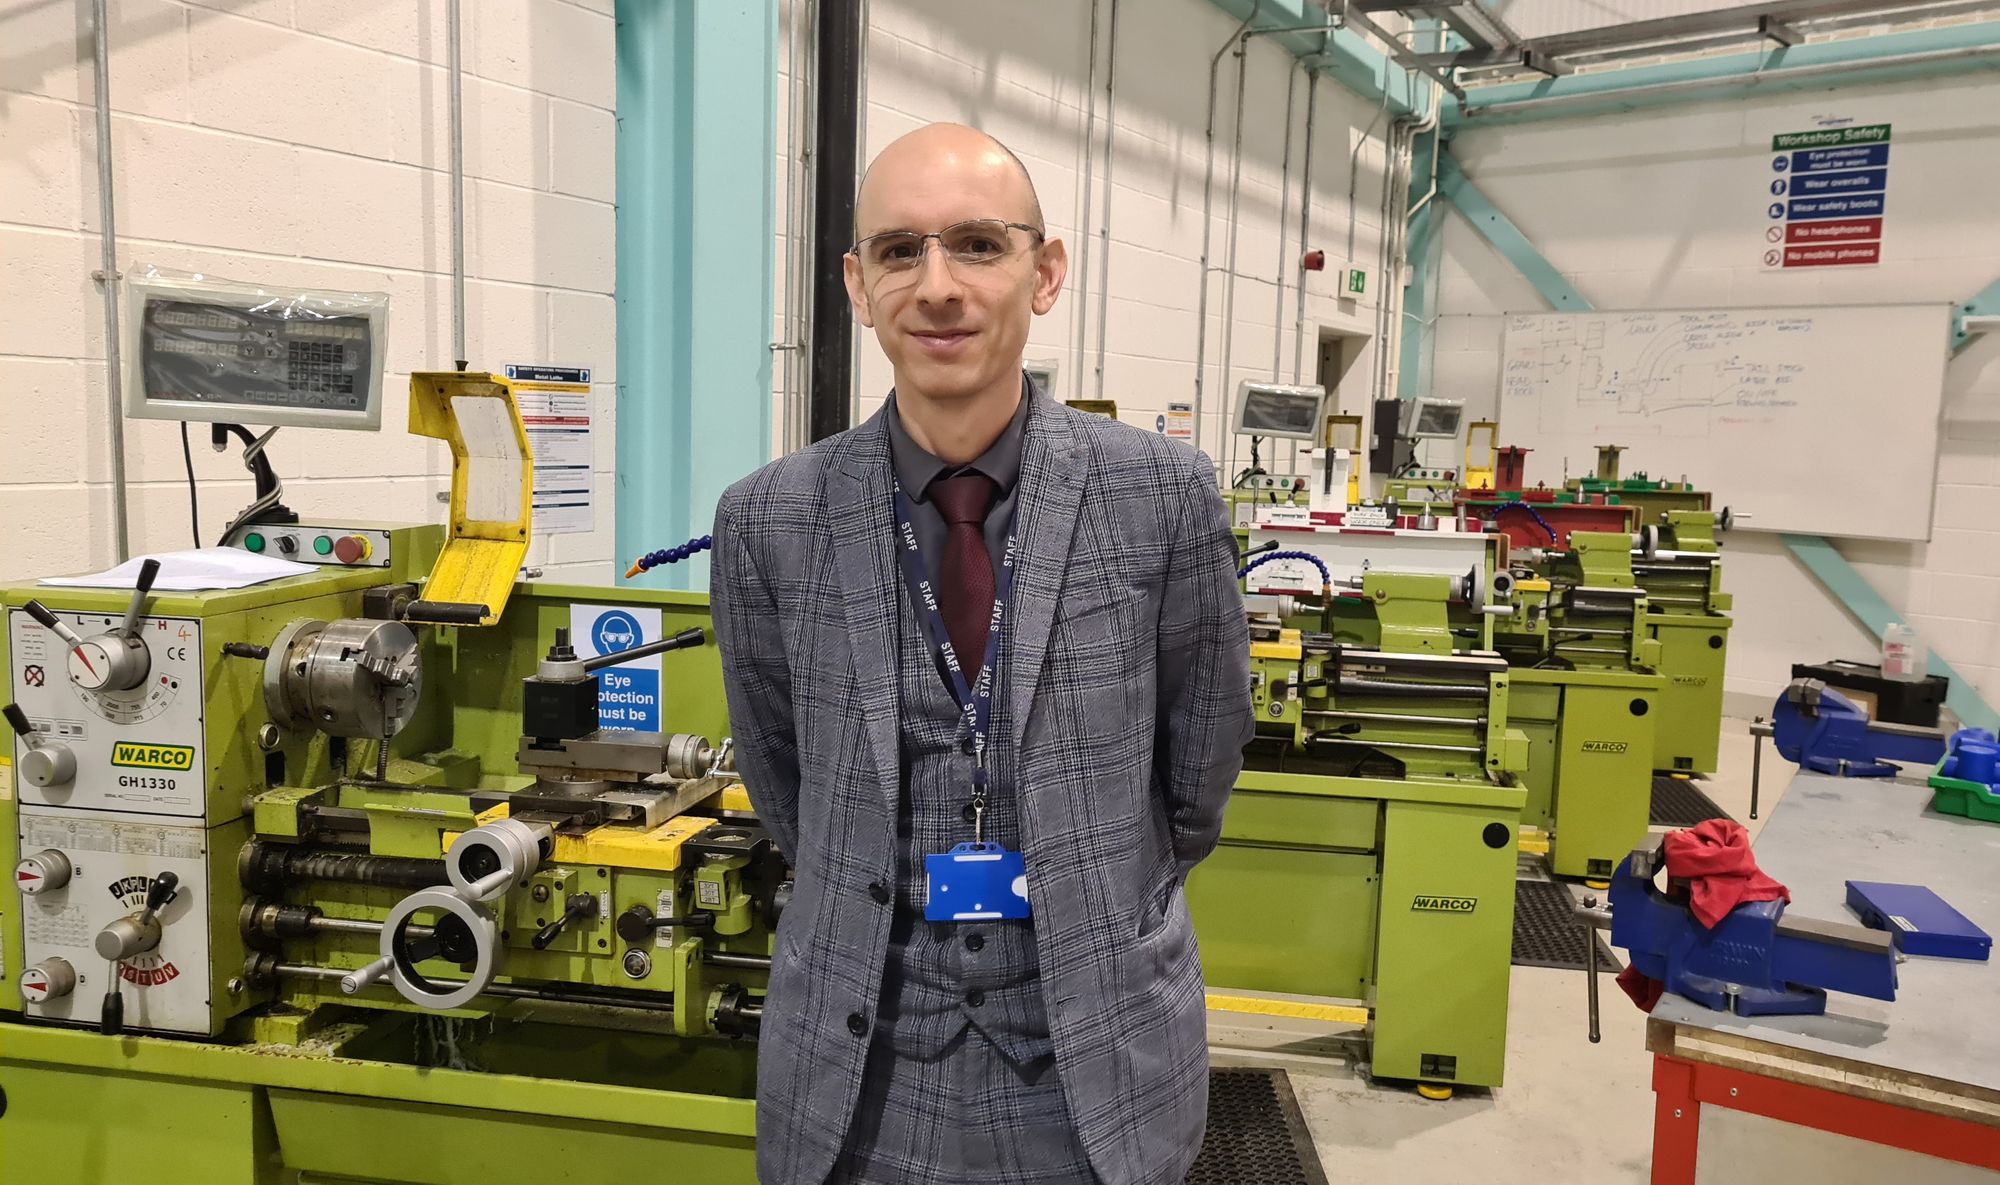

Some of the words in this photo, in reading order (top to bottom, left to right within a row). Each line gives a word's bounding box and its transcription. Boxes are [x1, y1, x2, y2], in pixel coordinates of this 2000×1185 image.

[1778, 132, 1841, 147] Workshop
[1844, 127, 1886, 141] Safety
[1809, 152, 1825, 161] Eye
[1826, 148, 1870, 160] protection
[1833, 160, 1844, 168] be
[1846, 159, 1868, 167] worn
[1805, 180, 1829, 189] Wear
[1830, 177, 1870, 187] overalls
[1793, 203, 1817, 212] Wear
[1818, 201, 1848, 211] safety
[1849, 199, 1878, 209] boots
[1795, 228, 1810, 237] No
[1811, 225, 1871, 237] headphones
[1787, 251, 1802, 260] No
[1803, 250, 1836, 260] mobile
[1837, 249, 1874, 260] phones
[902, 521, 918, 552] STAFF
[1004, 535, 1017, 567] STAFF
[920, 580, 938, 612] STAFF
[990, 599, 1004, 632] STAFF
[77, 616, 85, 626] L
[158, 621, 167, 631] H
[178, 625, 192, 642] 4
[167, 647, 186, 661] CE
[941, 642, 961, 673] STAFF
[605, 673, 631, 689] Eye
[980, 665, 993, 698] STAFF
[598, 690, 654, 705] otection
[629, 708, 647, 721] be
[964, 703, 977, 731] STA
[975, 732, 986, 753] AFF
[119, 747, 187, 765] WARCO
[119, 776, 176, 790] GH1330
[1418, 898, 1471, 910] WARCO
